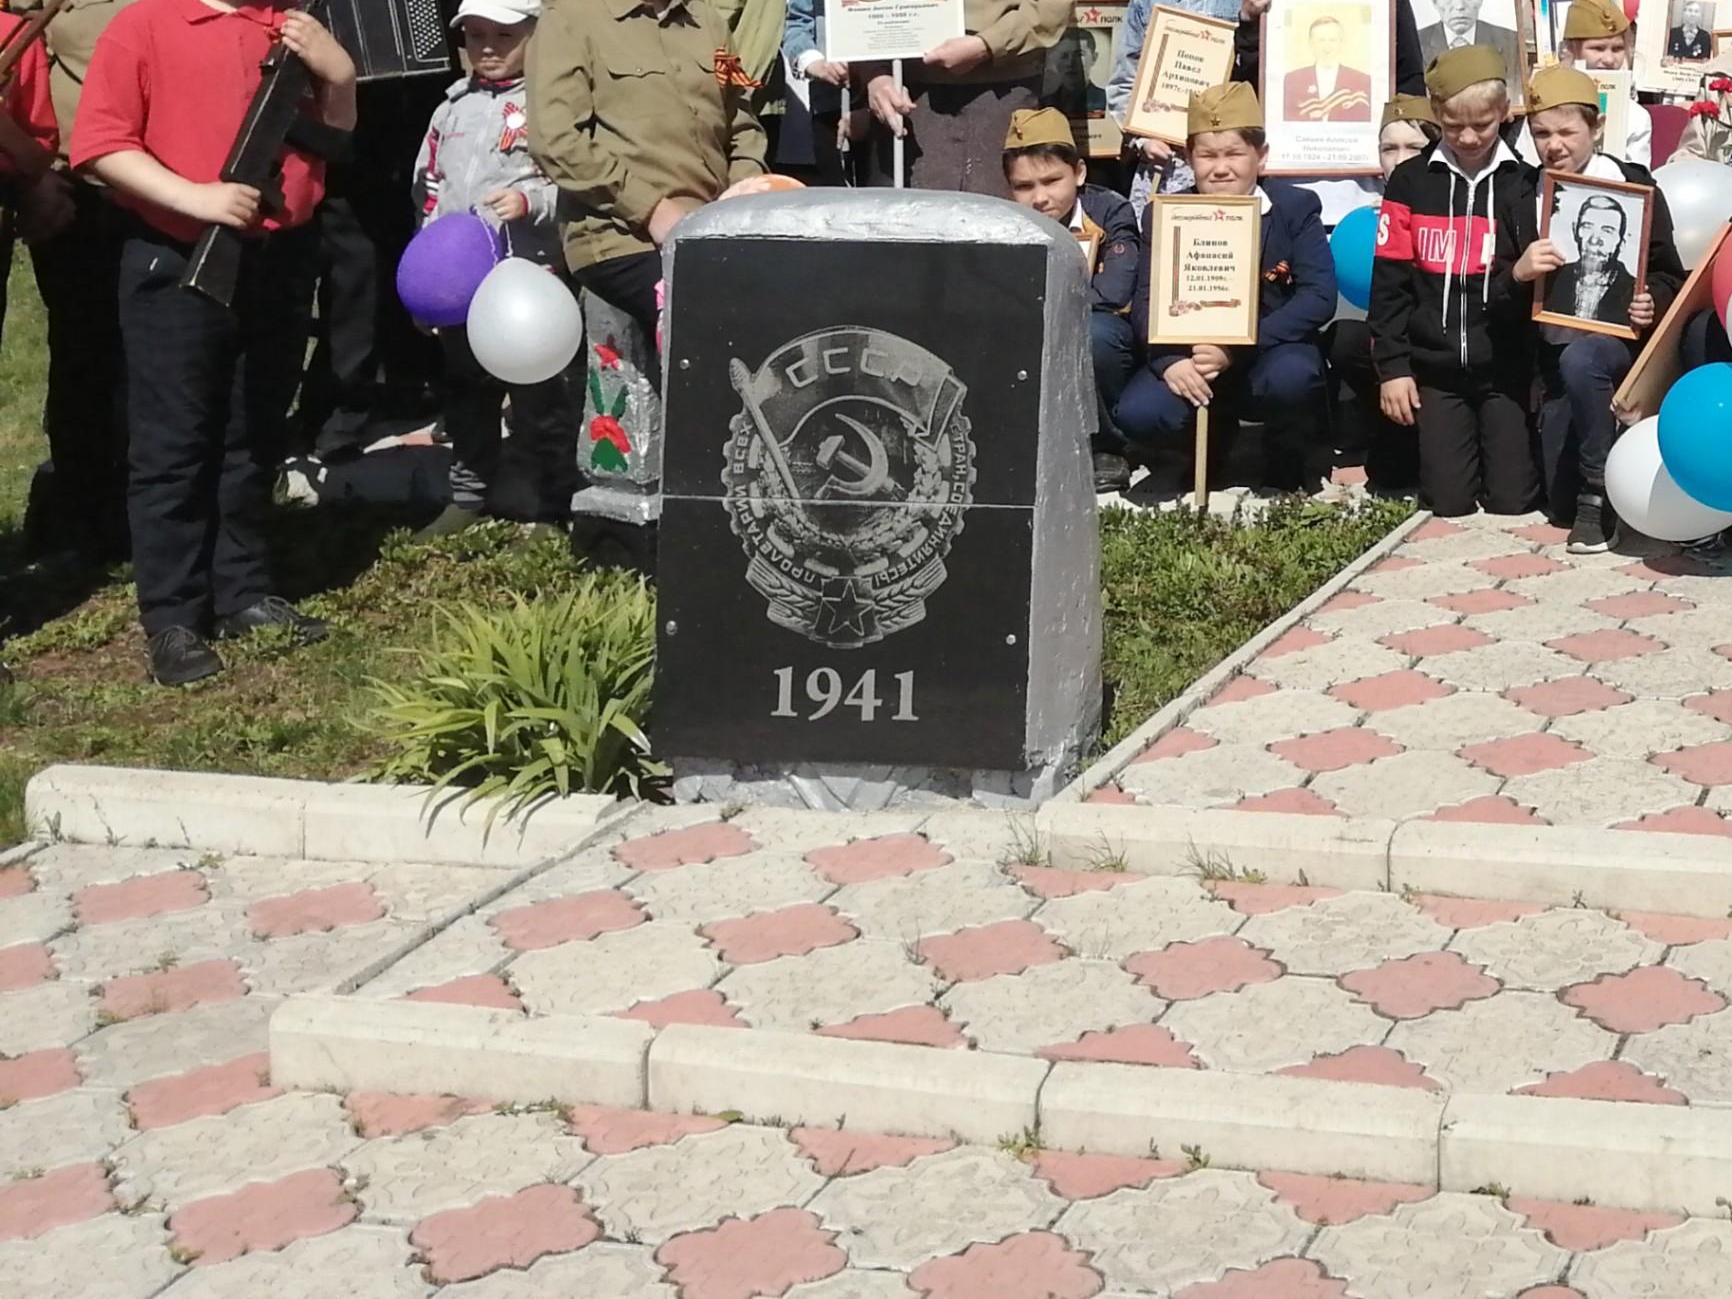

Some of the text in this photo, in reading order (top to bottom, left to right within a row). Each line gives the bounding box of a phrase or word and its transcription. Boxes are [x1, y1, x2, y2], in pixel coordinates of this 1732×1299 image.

[1174, 60, 1202, 74] Павел
[1183, 263, 1236, 272] Яковлевич
[771, 665, 920, 722] 1941
